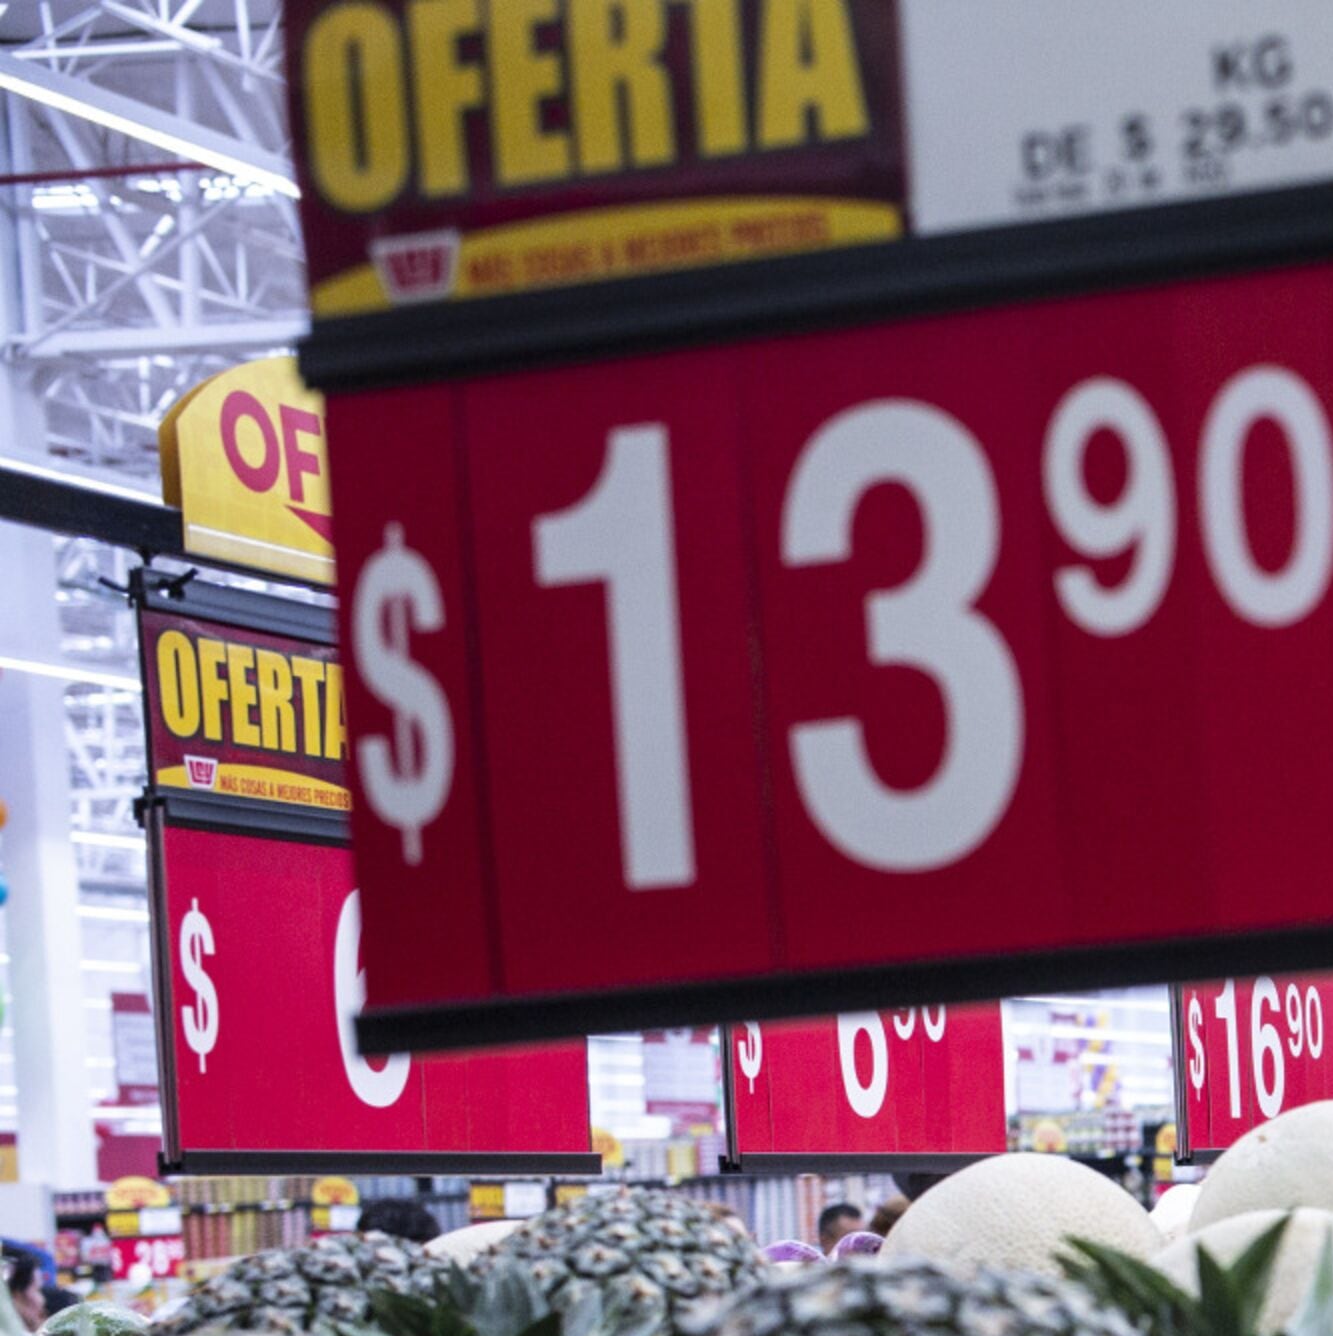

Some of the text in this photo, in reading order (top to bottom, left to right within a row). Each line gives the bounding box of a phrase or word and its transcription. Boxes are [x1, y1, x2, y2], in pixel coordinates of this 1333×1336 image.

[1210, 32, 1294, 94] KG
[303, 0, 869, 213] OFERTA
[1020, 126, 1092, 180] DE
